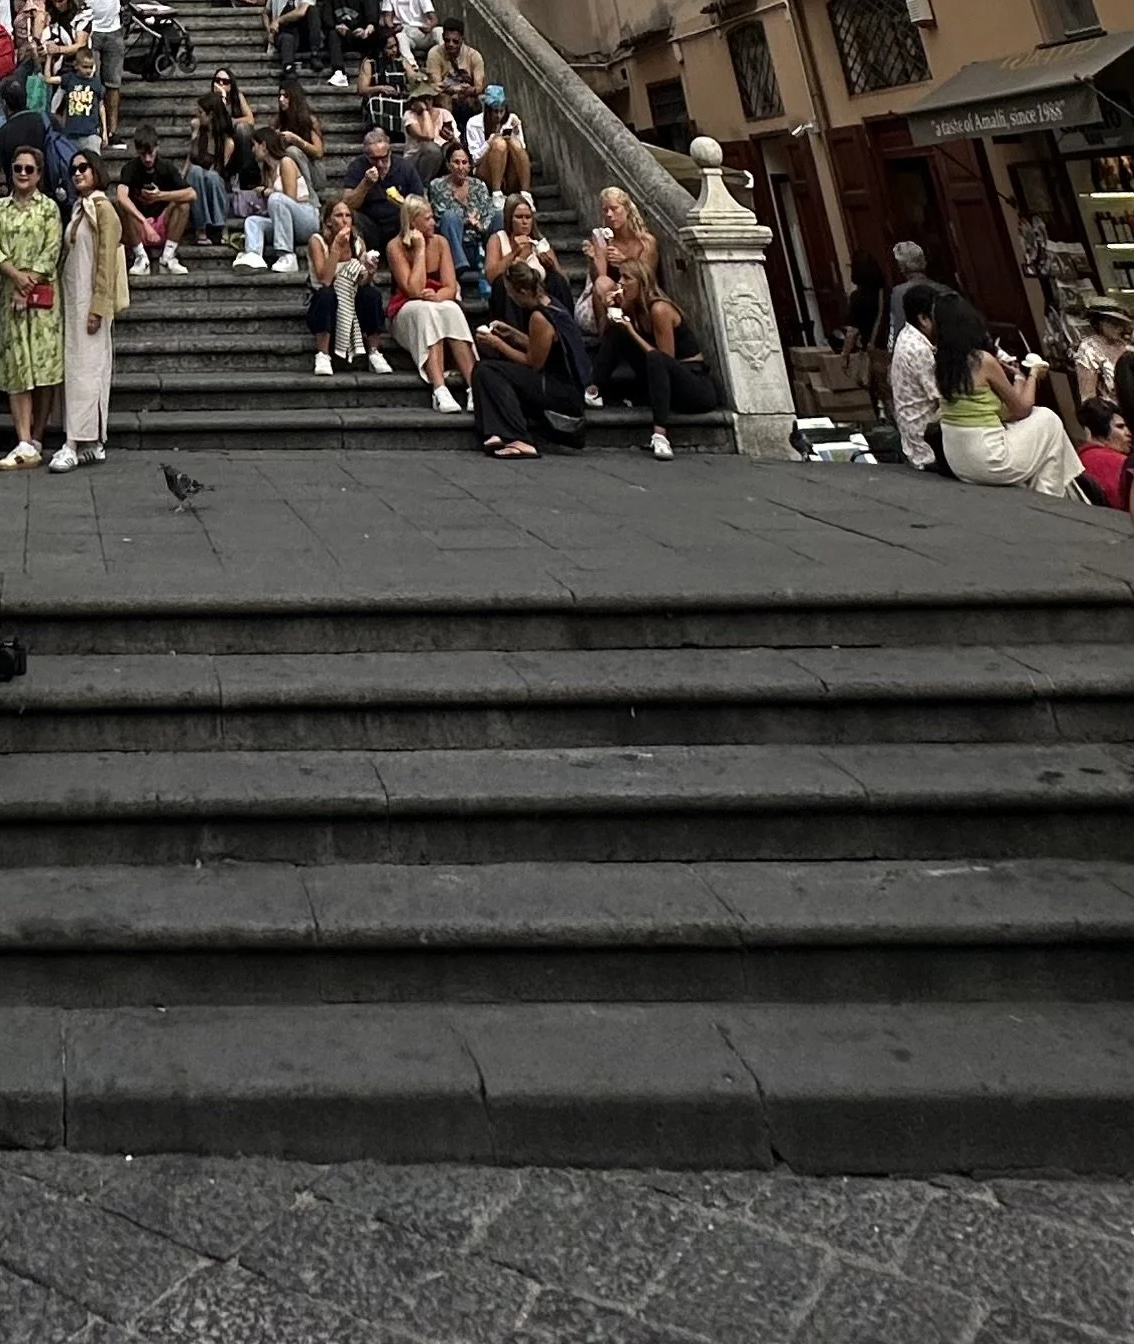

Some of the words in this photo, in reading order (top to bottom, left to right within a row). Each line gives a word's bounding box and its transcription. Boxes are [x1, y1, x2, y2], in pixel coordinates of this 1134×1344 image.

[942, 118, 963, 135] taste
[964, 114, 975, 133] of
[1010, 108, 1037, 126] since
